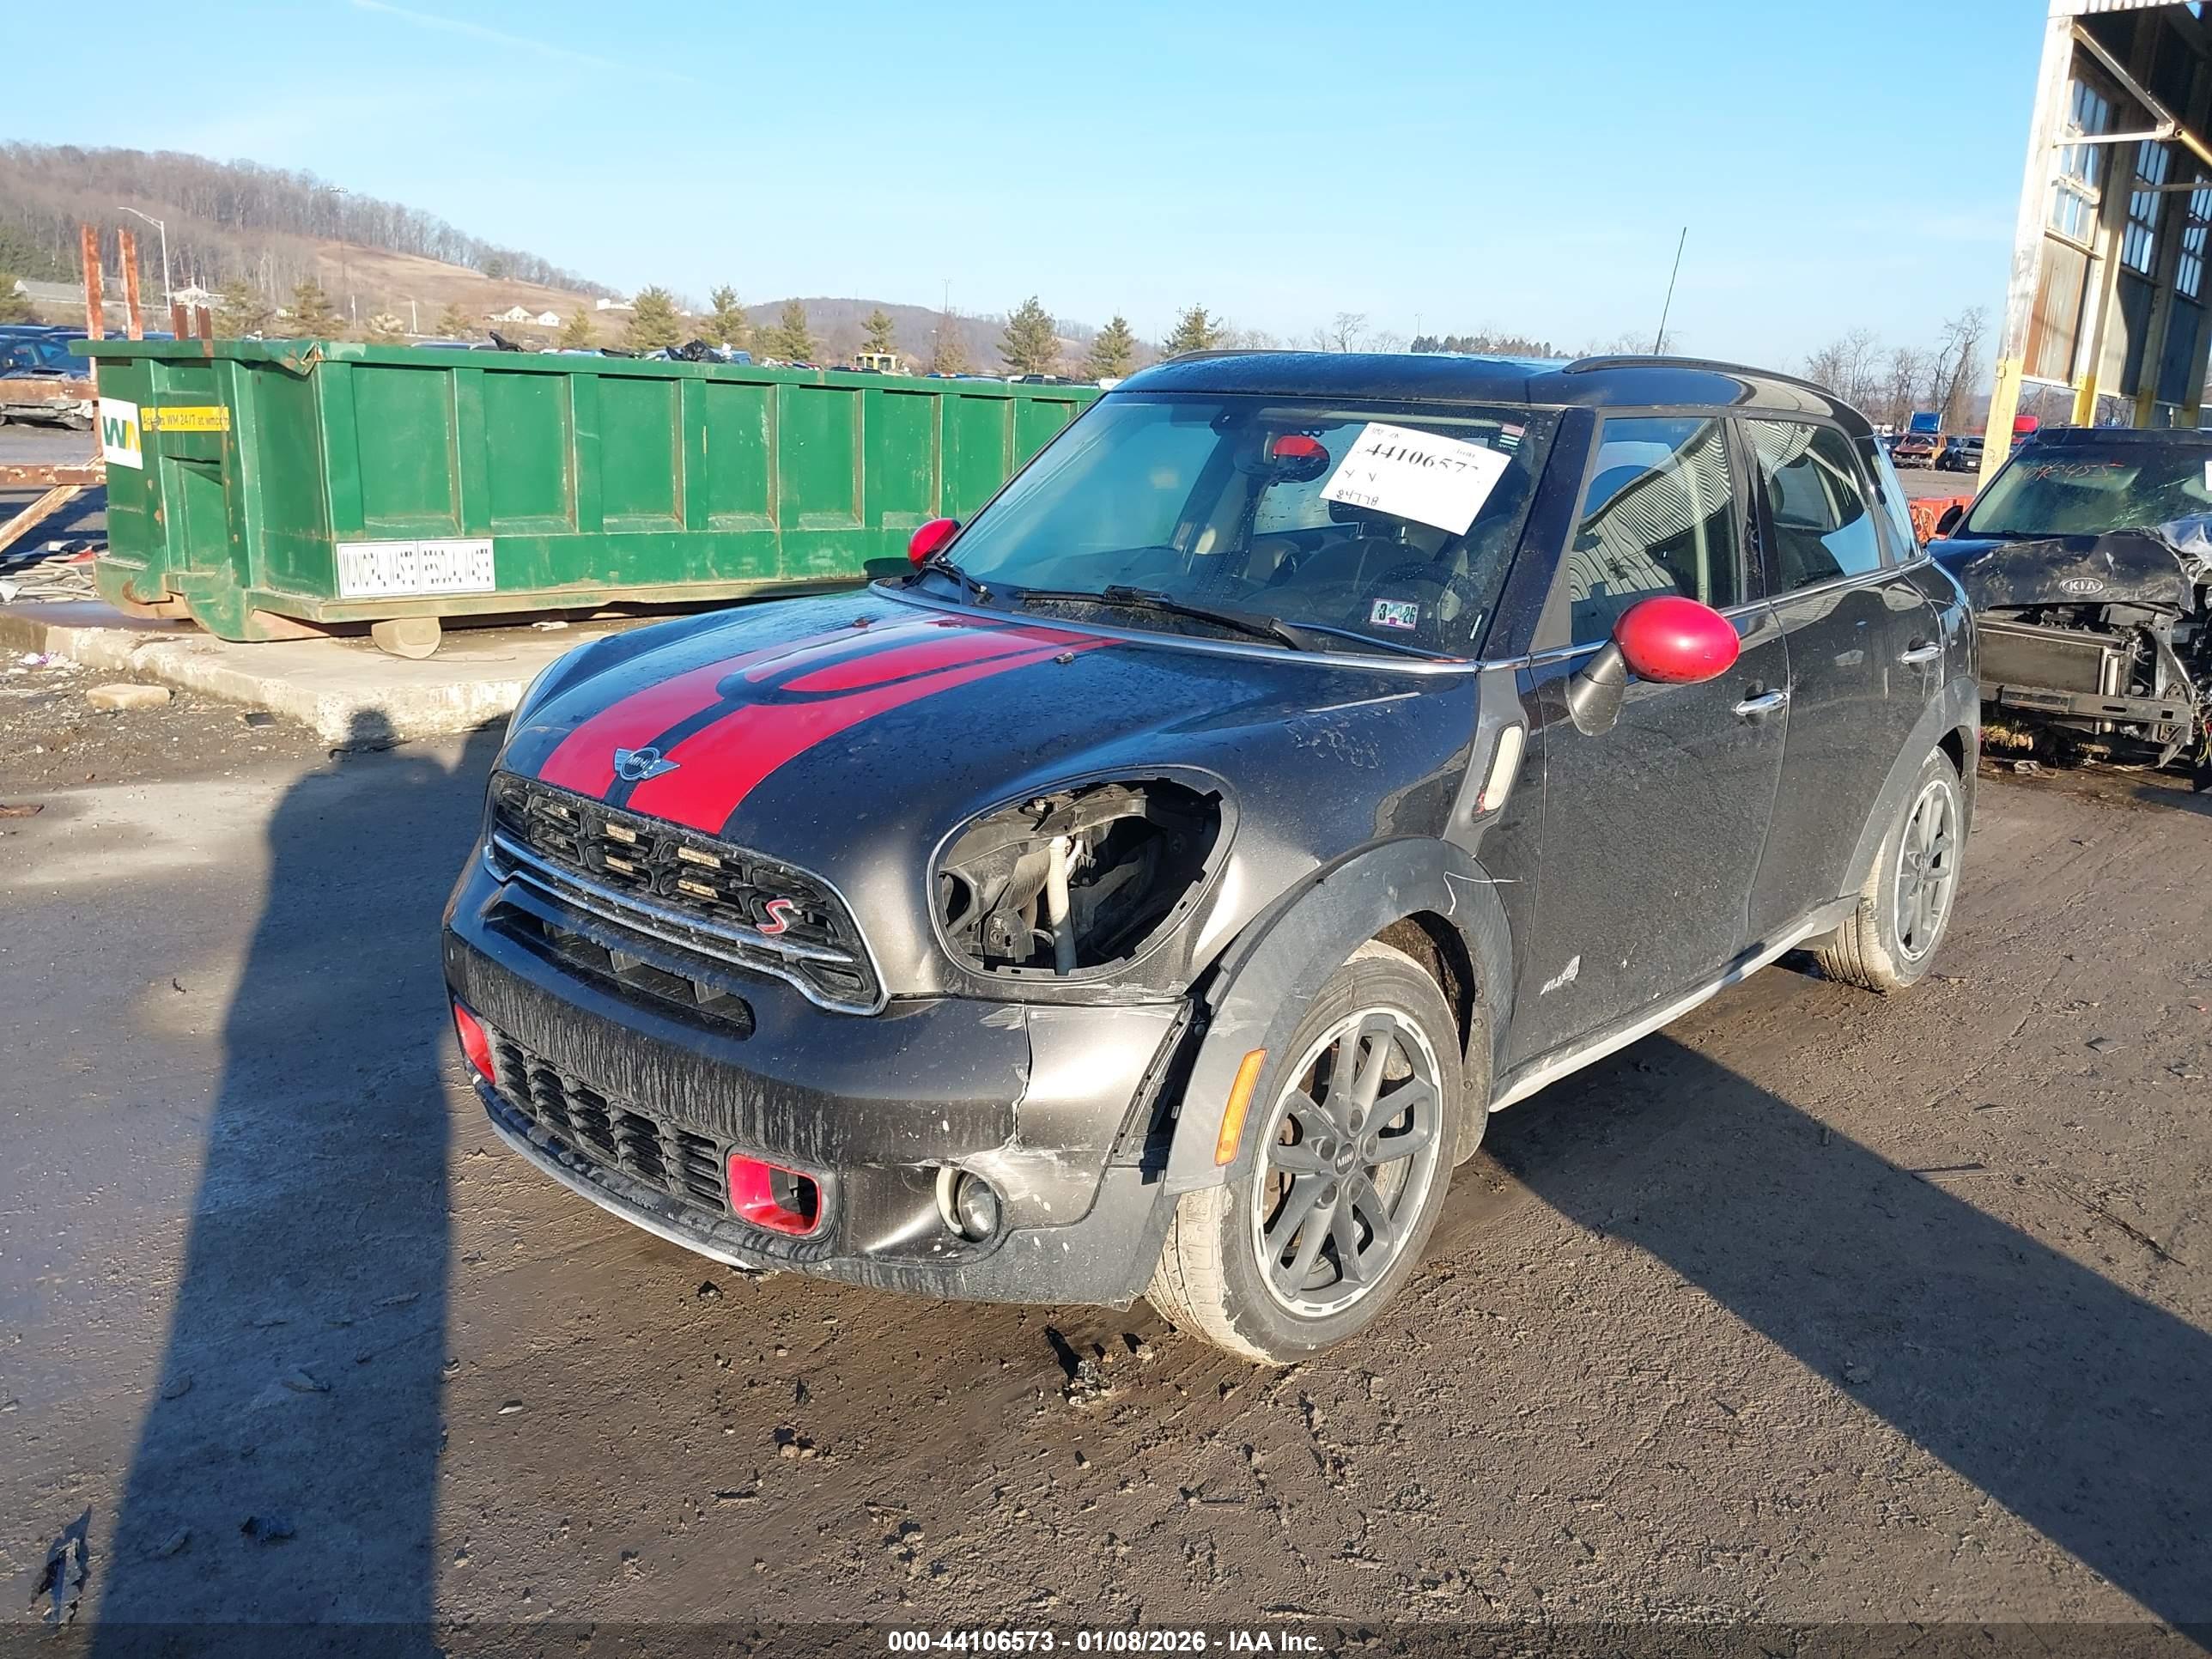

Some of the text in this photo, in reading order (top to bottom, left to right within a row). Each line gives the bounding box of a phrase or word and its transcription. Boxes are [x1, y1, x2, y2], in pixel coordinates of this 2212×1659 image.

[167, 414, 179, 426] WM
[179, 414, 196, 426] 24/7
[1377, 603, 1417, 624] 3 26
[626, 756, 651, 769] MINI
[756, 898, 794, 934] S
[1337, 1151, 1354, 1169] MINI
